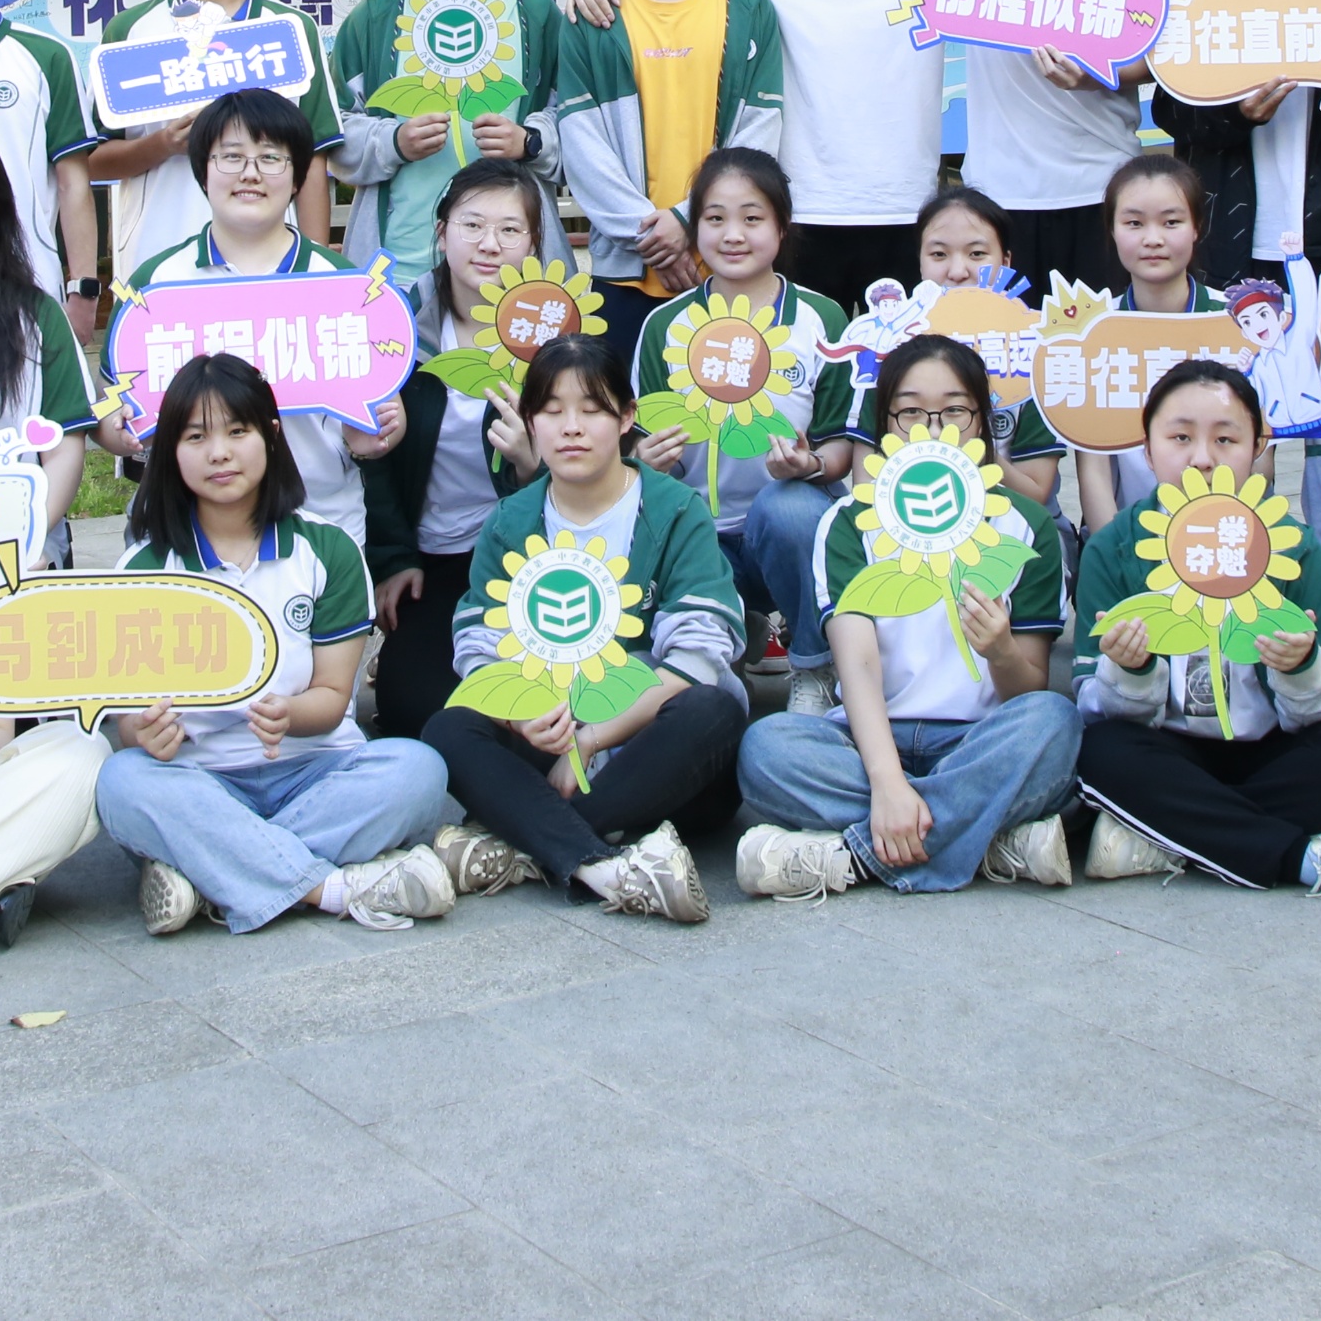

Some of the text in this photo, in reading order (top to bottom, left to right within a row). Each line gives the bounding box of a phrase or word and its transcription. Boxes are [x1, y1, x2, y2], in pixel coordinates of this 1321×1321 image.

[119, 40, 288, 96] 一路前行
[515, 299, 567, 325] 一举
[508, 317, 560, 347] 夺魁
[705, 336, 755, 362] 一举
[701, 356, 751, 388] 夺魁
[1186, 515, 1249, 547] 一举
[1185, 544, 1248, 577] 夺魁
